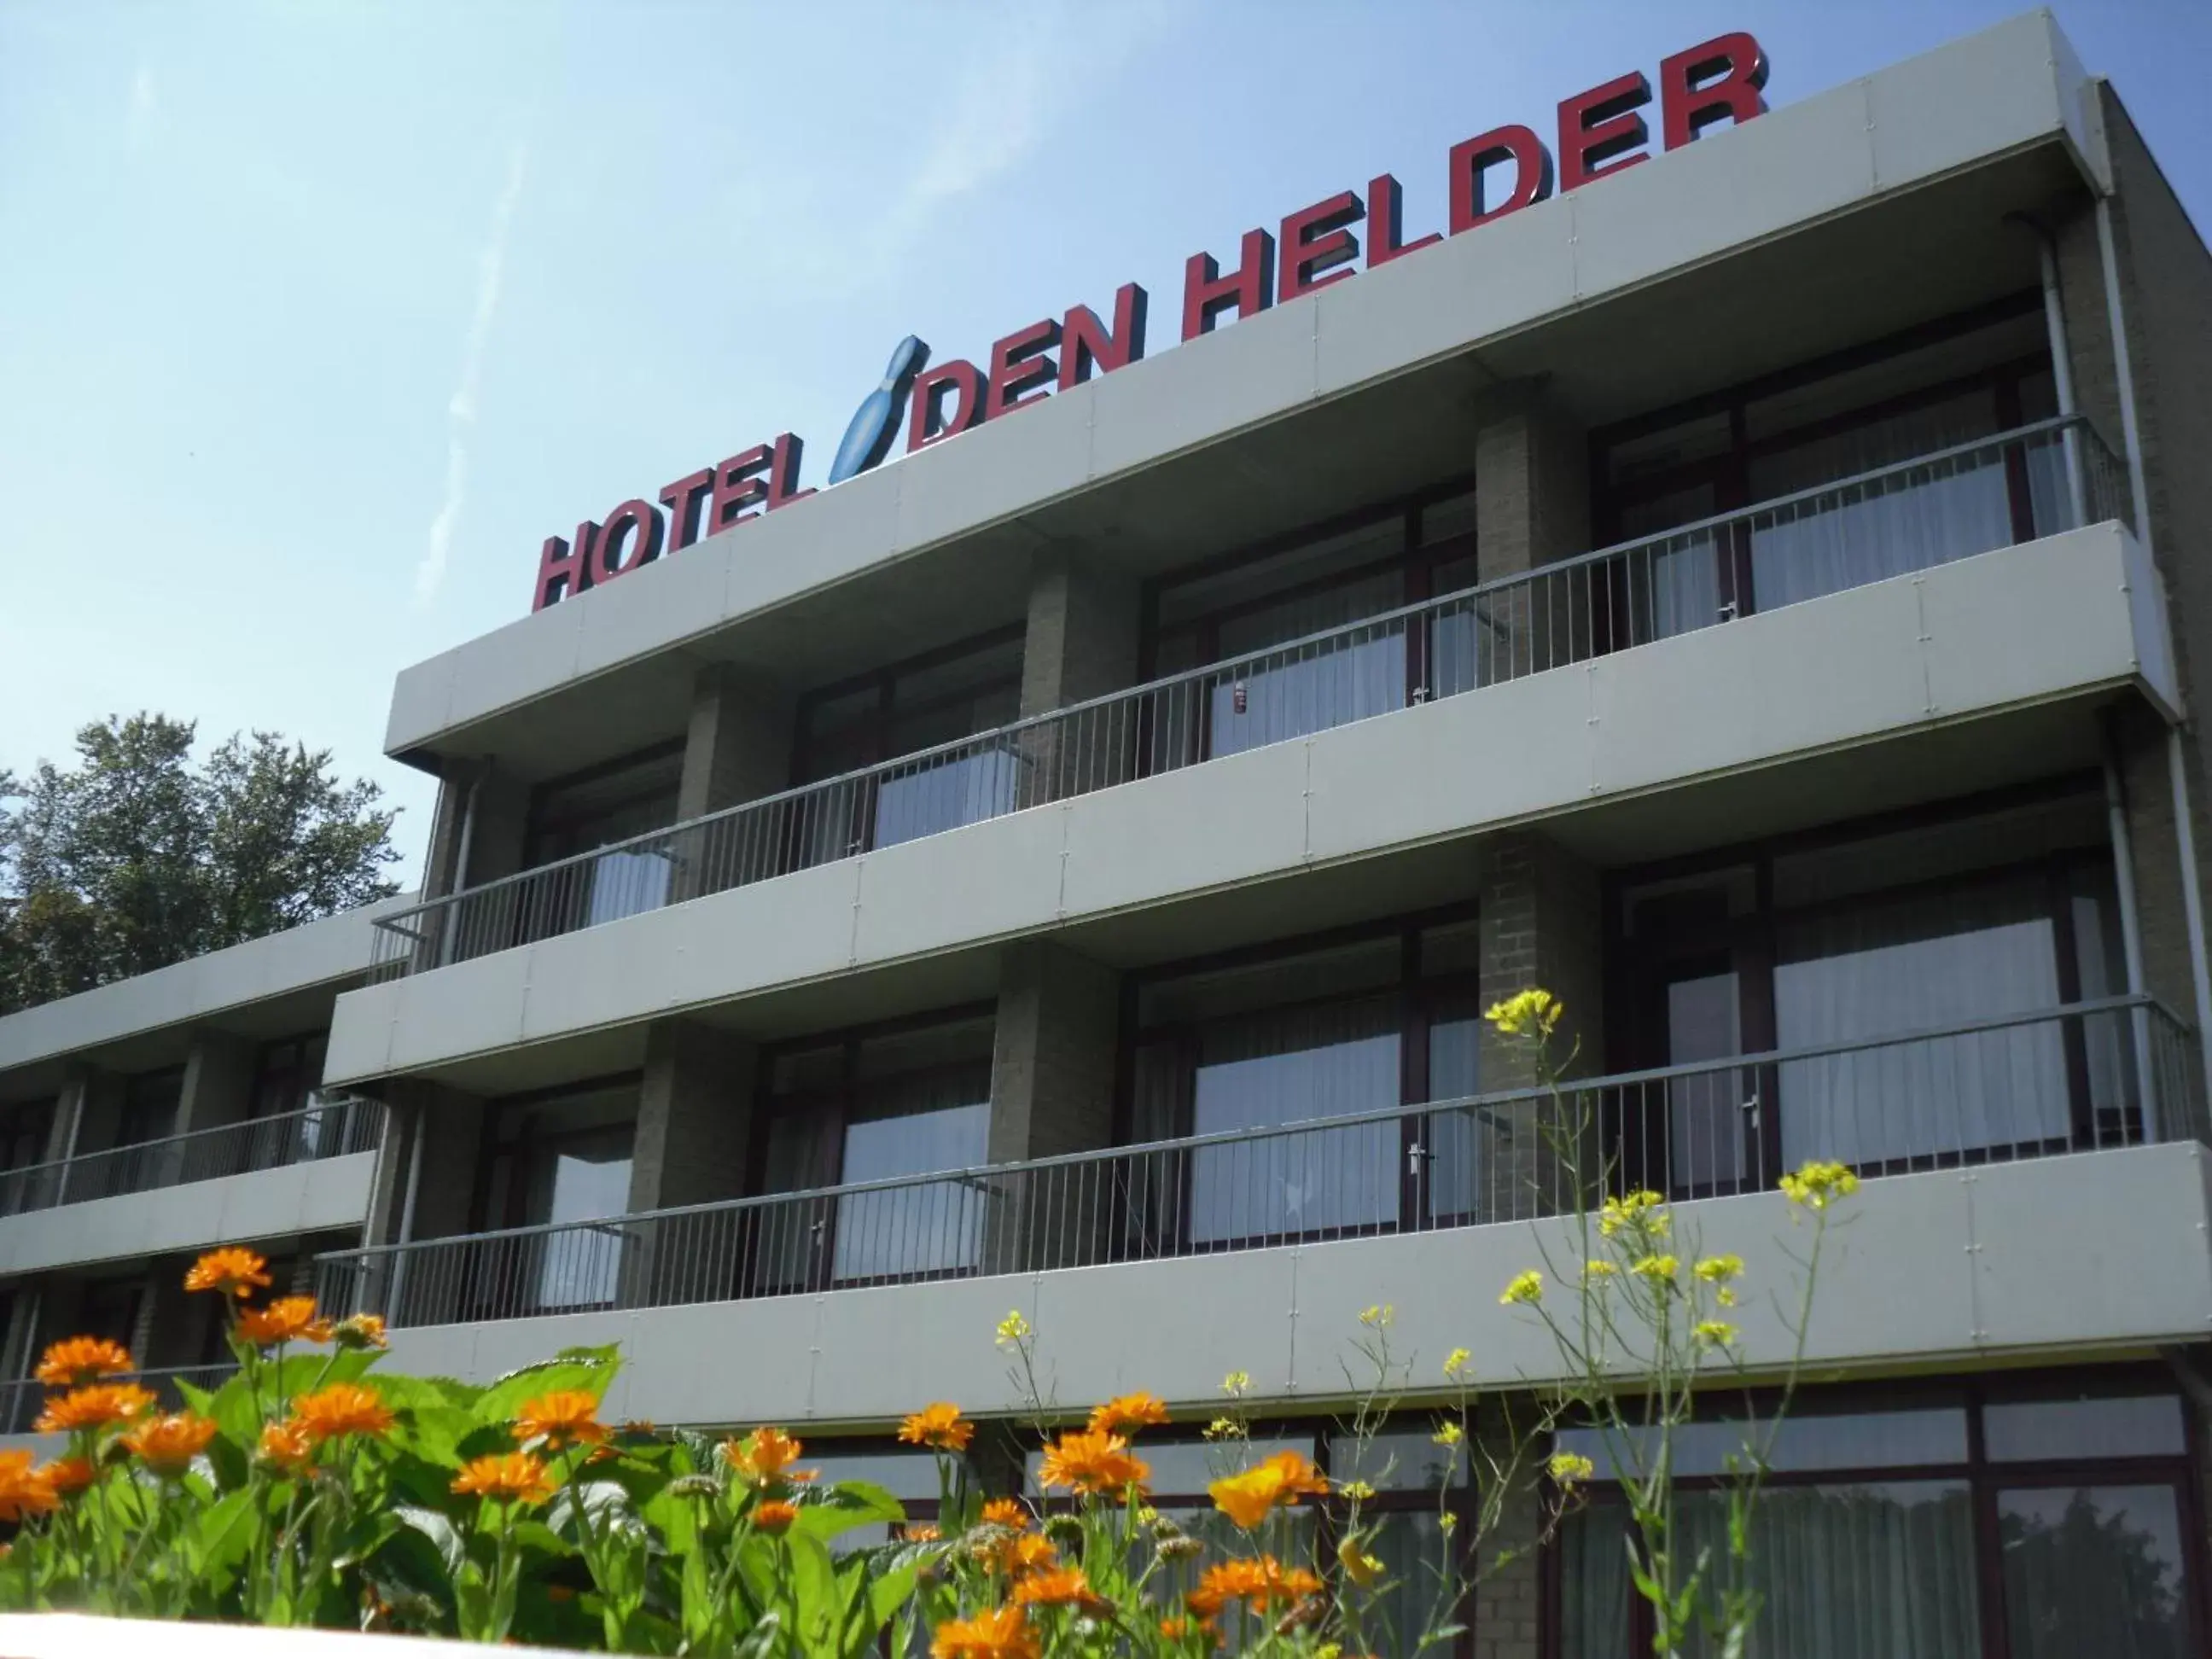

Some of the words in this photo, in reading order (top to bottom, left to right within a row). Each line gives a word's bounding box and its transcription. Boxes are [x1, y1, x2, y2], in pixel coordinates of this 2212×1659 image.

[532, 431, 819, 613] HOTEL
[907, 282, 1148, 453] DEN
[1181, 32, 1770, 344] HELDER
